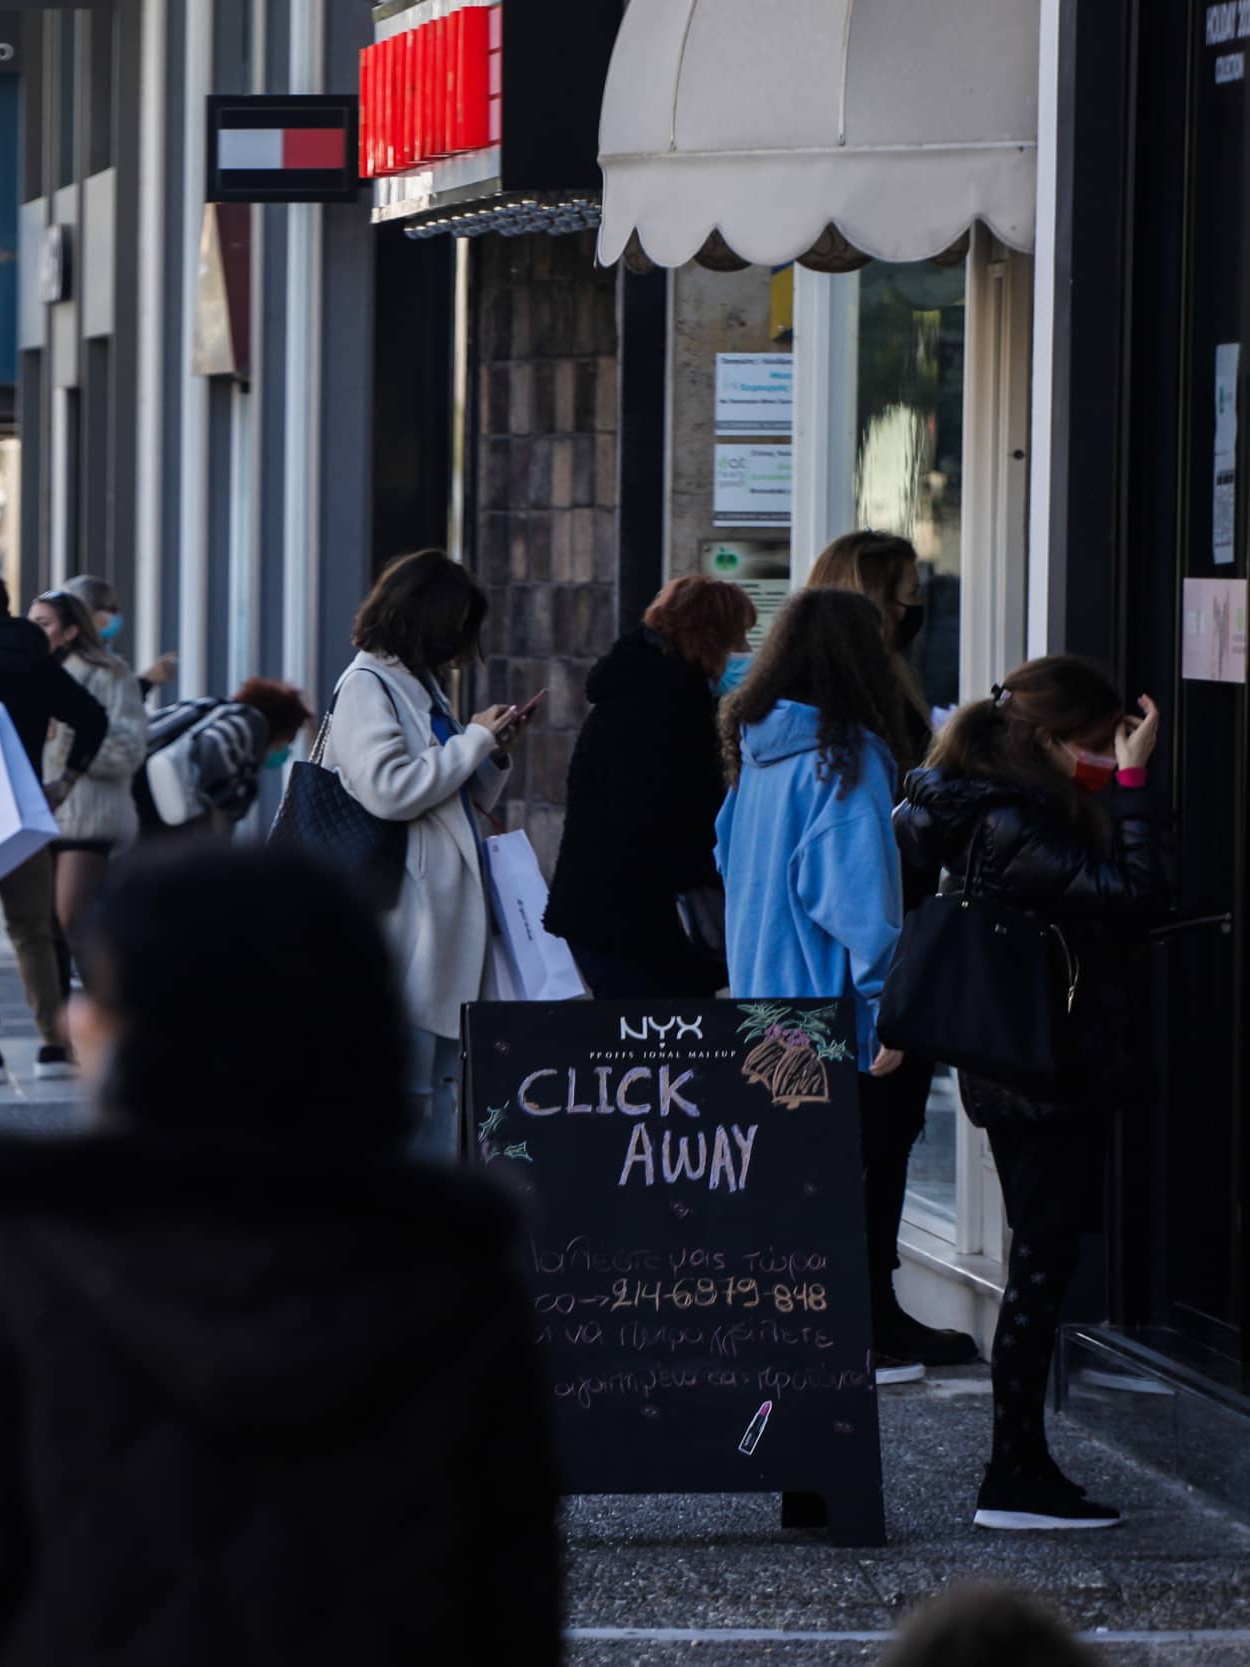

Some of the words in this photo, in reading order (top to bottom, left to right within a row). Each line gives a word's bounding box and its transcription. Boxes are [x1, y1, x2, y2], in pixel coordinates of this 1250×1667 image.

[620, 1015, 703, 1040] NYX
[589, 1050, 681, 1060] PROFESIONAL
[517, 1065, 700, 1118] CLICK
[618, 1122, 759, 1193] AWAY
